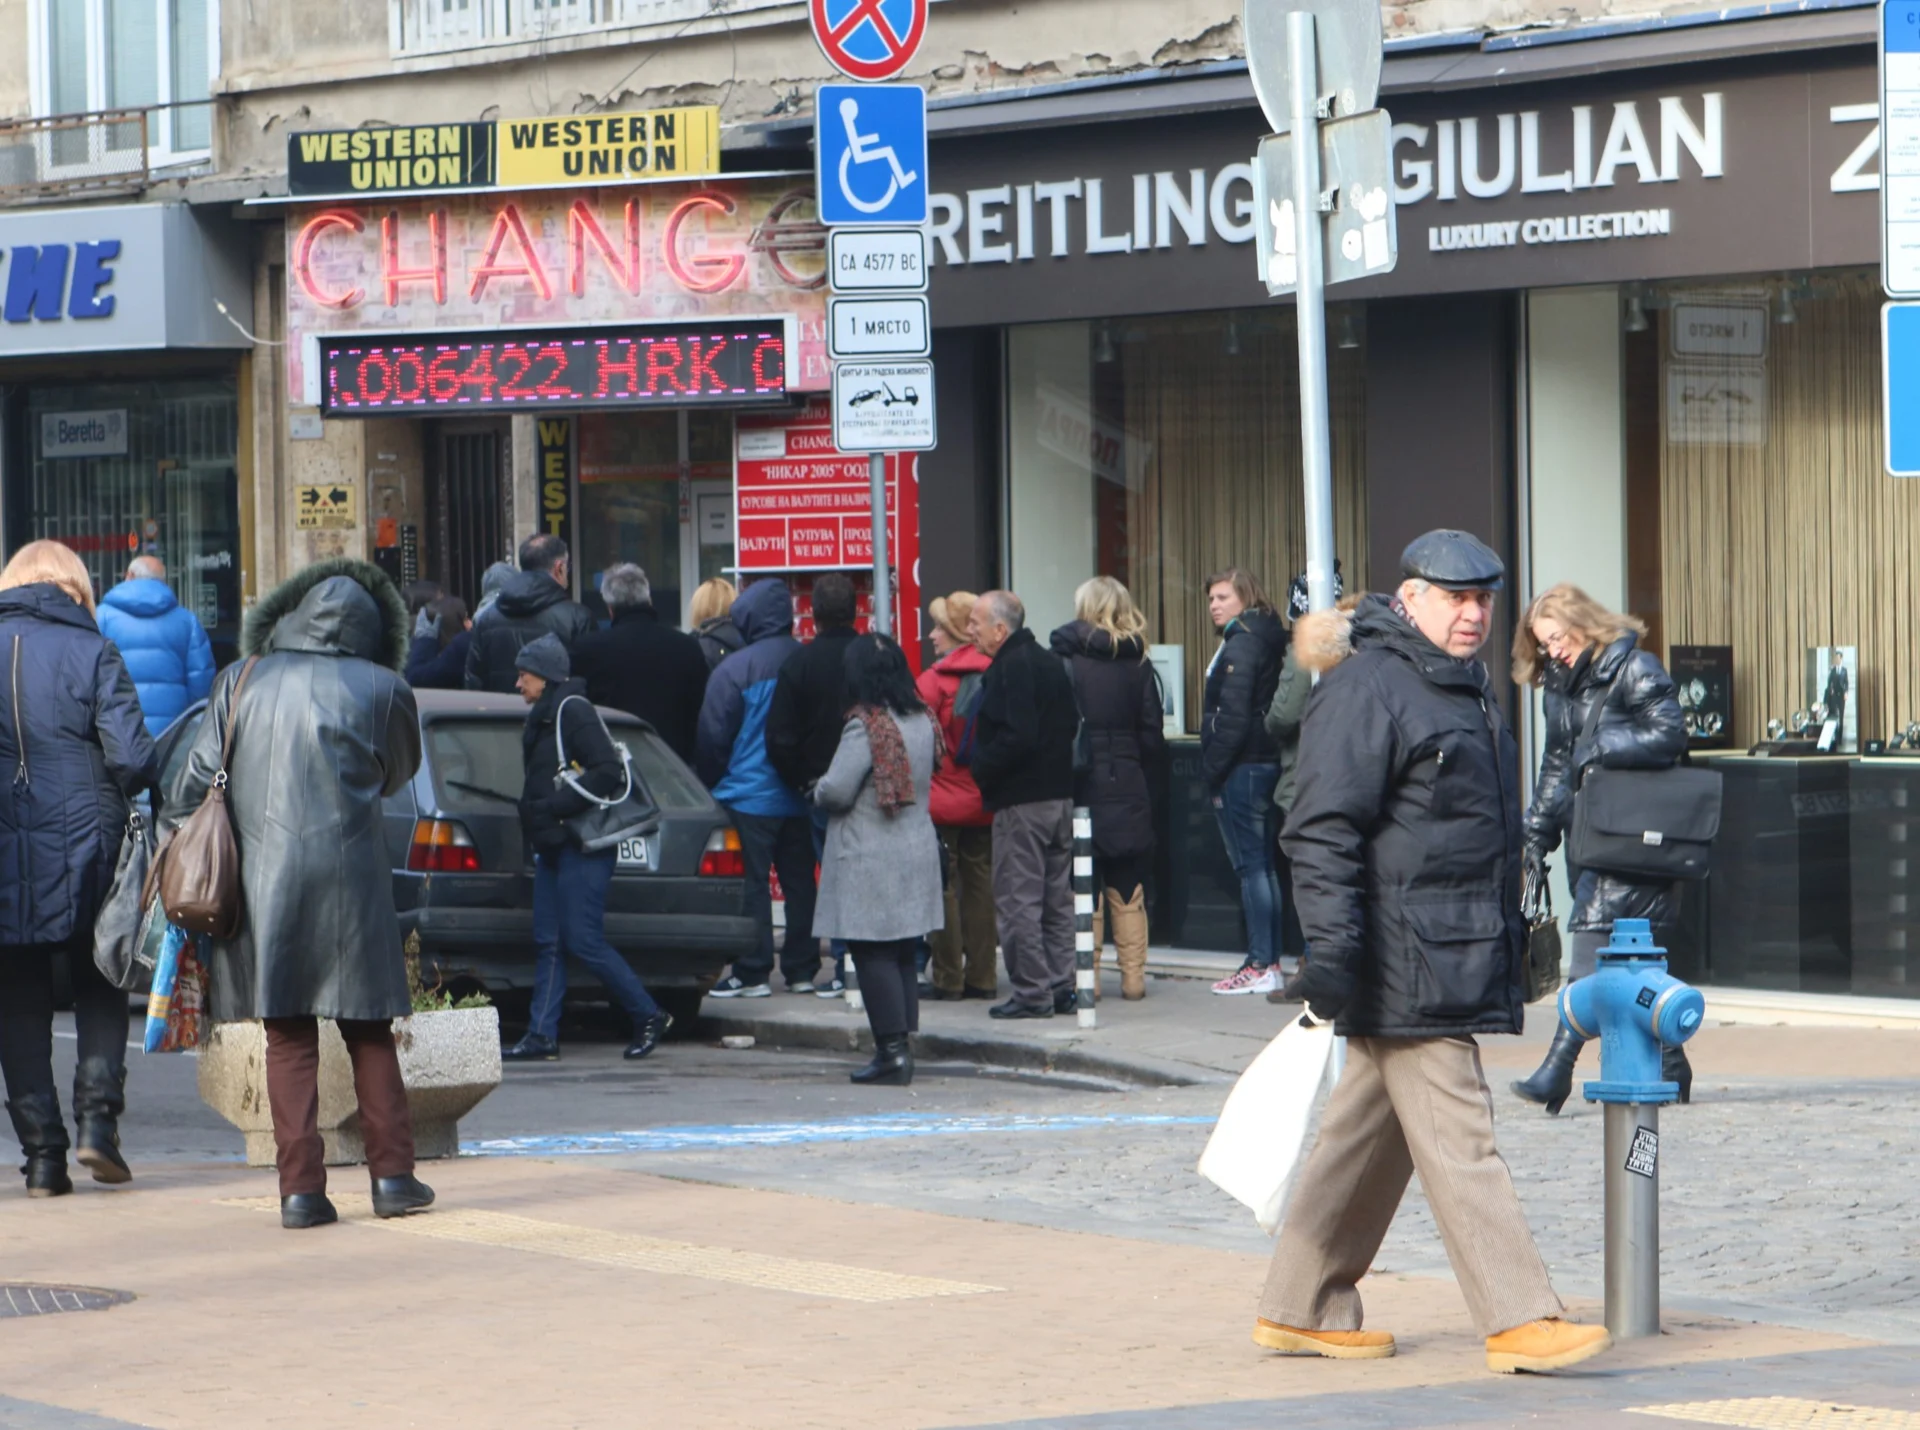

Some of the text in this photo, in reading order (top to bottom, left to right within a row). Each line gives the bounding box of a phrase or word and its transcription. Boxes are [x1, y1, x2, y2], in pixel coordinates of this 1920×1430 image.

[301, 126, 460, 162] WESTERN
[511, 113, 675, 149] WESTERN
[563, 146, 675, 176] UNION
[1391, 92, 1725, 204] GIULIAN
[1830, 103, 1880, 193] Z
[351, 156, 460, 190] UNION
[928, 163, 1257, 266] REITLING
[1429, 209, 1670, 251] LUXURY COLLECTION
[864, 254, 895, 271] 4577
[851, 317, 911, 335] 1 МЯСТО
[594, 341, 727, 397] HRK
[58, 419, 105, 444] Beretta
[791, 435, 835, 450] CHANG
[740, 535, 785, 551] ВАЛУТИ
[793, 528, 834, 541] КУПУВА
[794, 544, 834, 557] WE BUY
[847, 543, 863, 556] WE
[620, 840, 643, 860] BC
